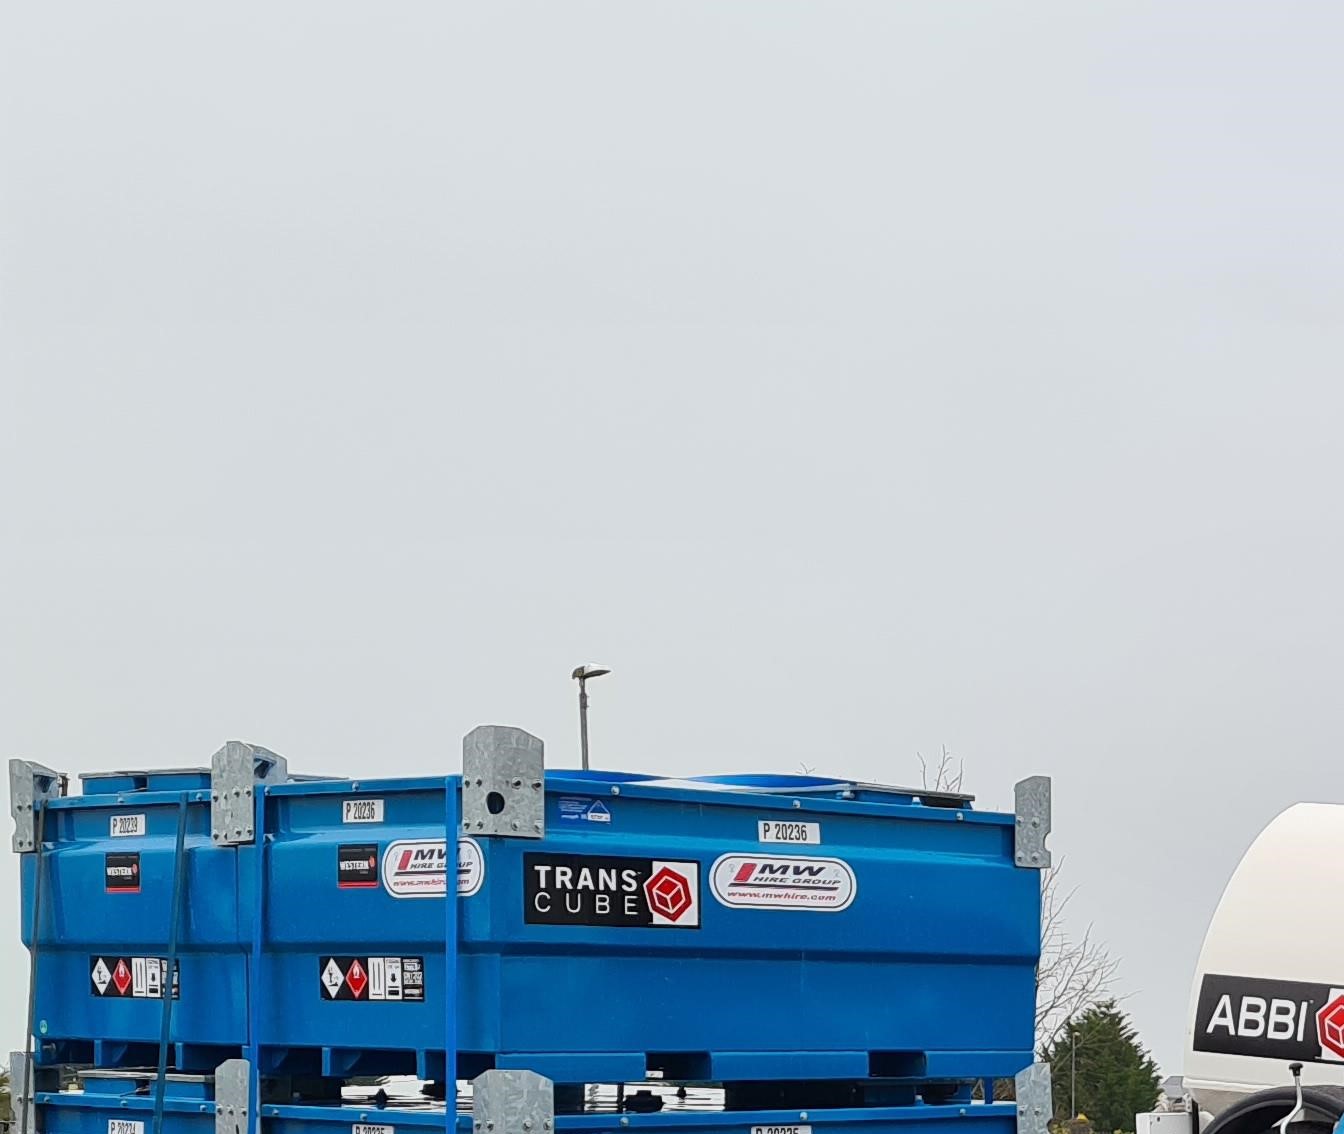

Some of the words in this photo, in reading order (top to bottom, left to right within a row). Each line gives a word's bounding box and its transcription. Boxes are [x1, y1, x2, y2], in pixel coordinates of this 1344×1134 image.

[346, 802, 351, 820] P
[353, 801, 375, 820] 20236
[763, 822, 770, 840] P
[774, 823, 808, 842] 20236
[533, 865, 638, 892] TRANS
[758, 863, 826, 877] MW
[753, 876, 789, 884] HIRE
[792, 877, 841, 886] GROUP
[534, 891, 639, 915] CUBE
[727, 891, 837, 902] www.mwhire.com
[1205, 994, 1309, 1042] ABBI
